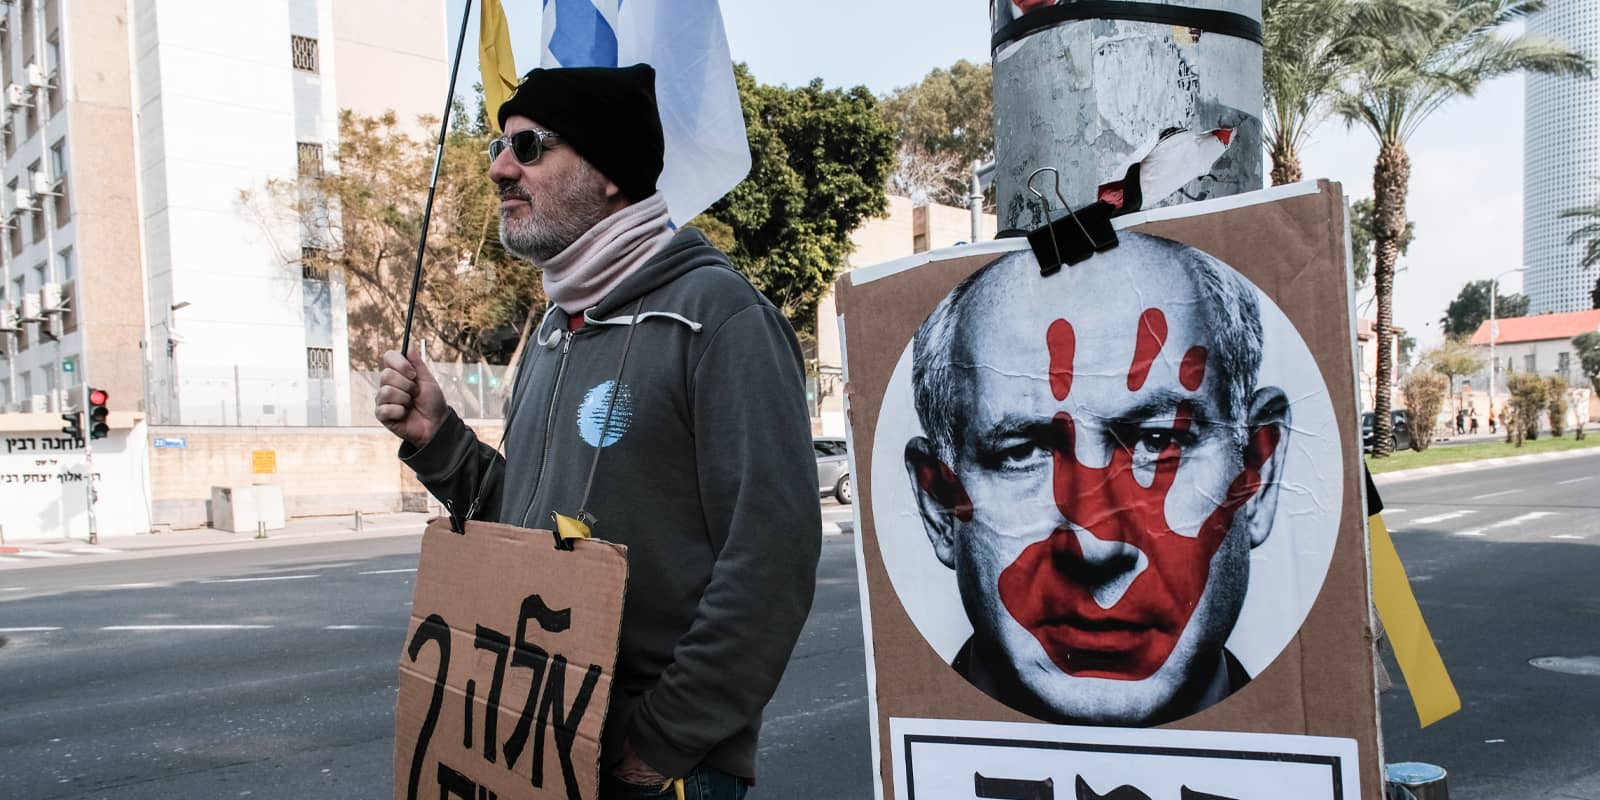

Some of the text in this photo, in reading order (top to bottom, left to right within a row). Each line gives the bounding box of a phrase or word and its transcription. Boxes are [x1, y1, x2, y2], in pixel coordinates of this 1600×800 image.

[5, 437, 86, 453] מחנה רבין
[23, 474, 52, 483] יצחק
